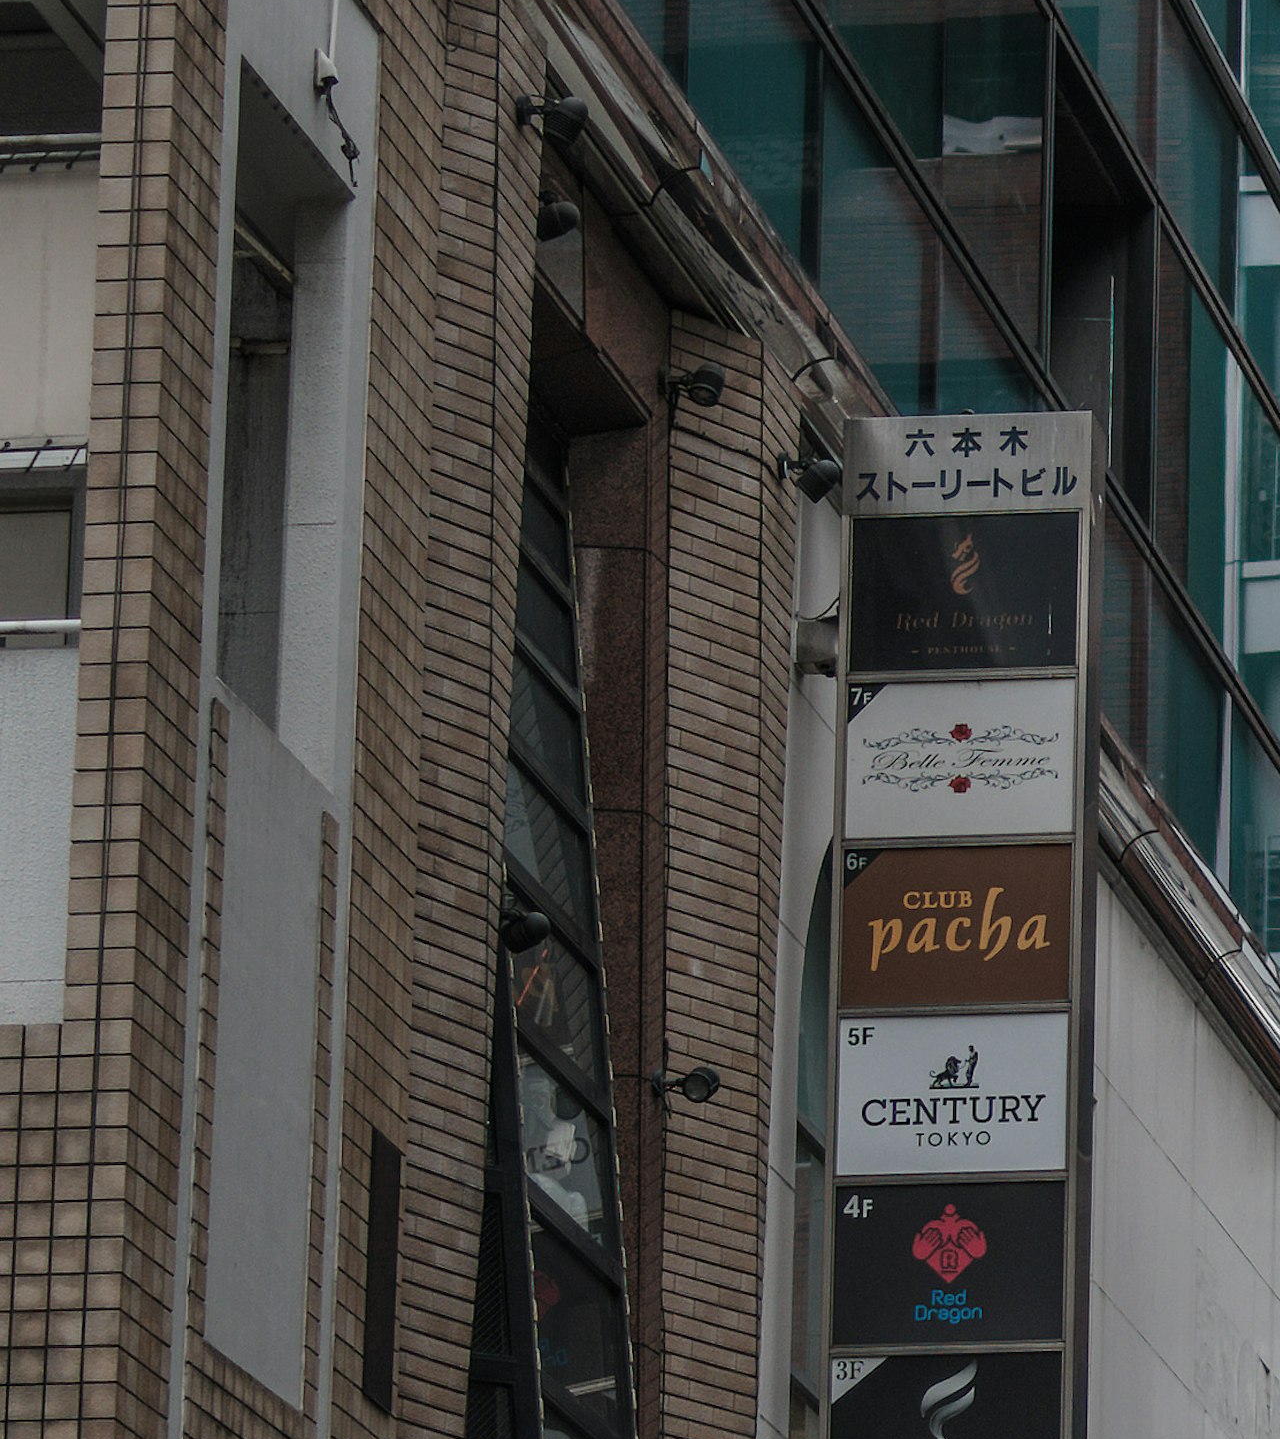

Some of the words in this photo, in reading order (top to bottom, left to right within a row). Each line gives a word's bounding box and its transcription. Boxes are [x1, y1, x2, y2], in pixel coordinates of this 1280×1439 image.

[905, 426, 1029, 458] 六本木
[856, 466, 1078, 501] ストーリートビル
[896, 610, 940, 631] Red
[850, 688, 873, 707] 7F
[871, 751, 946, 772] Belle
[951, 748, 1051, 770] Femme
[846, 852, 868, 871] 6F
[903, 890, 973, 910] CLUB
[867, 887, 1051, 972] pacha
[847, 1027, 875, 1046] 5F
[861, 1094, 1046, 1126] CENTURY
[916, 1130, 991, 1147] TOKYO
[843, 1194, 874, 1219] 4F
[931, 1289, 967, 1307] Red
[914, 1304, 983, 1324] Dragon
[836, 1361, 865, 1380] 3F
